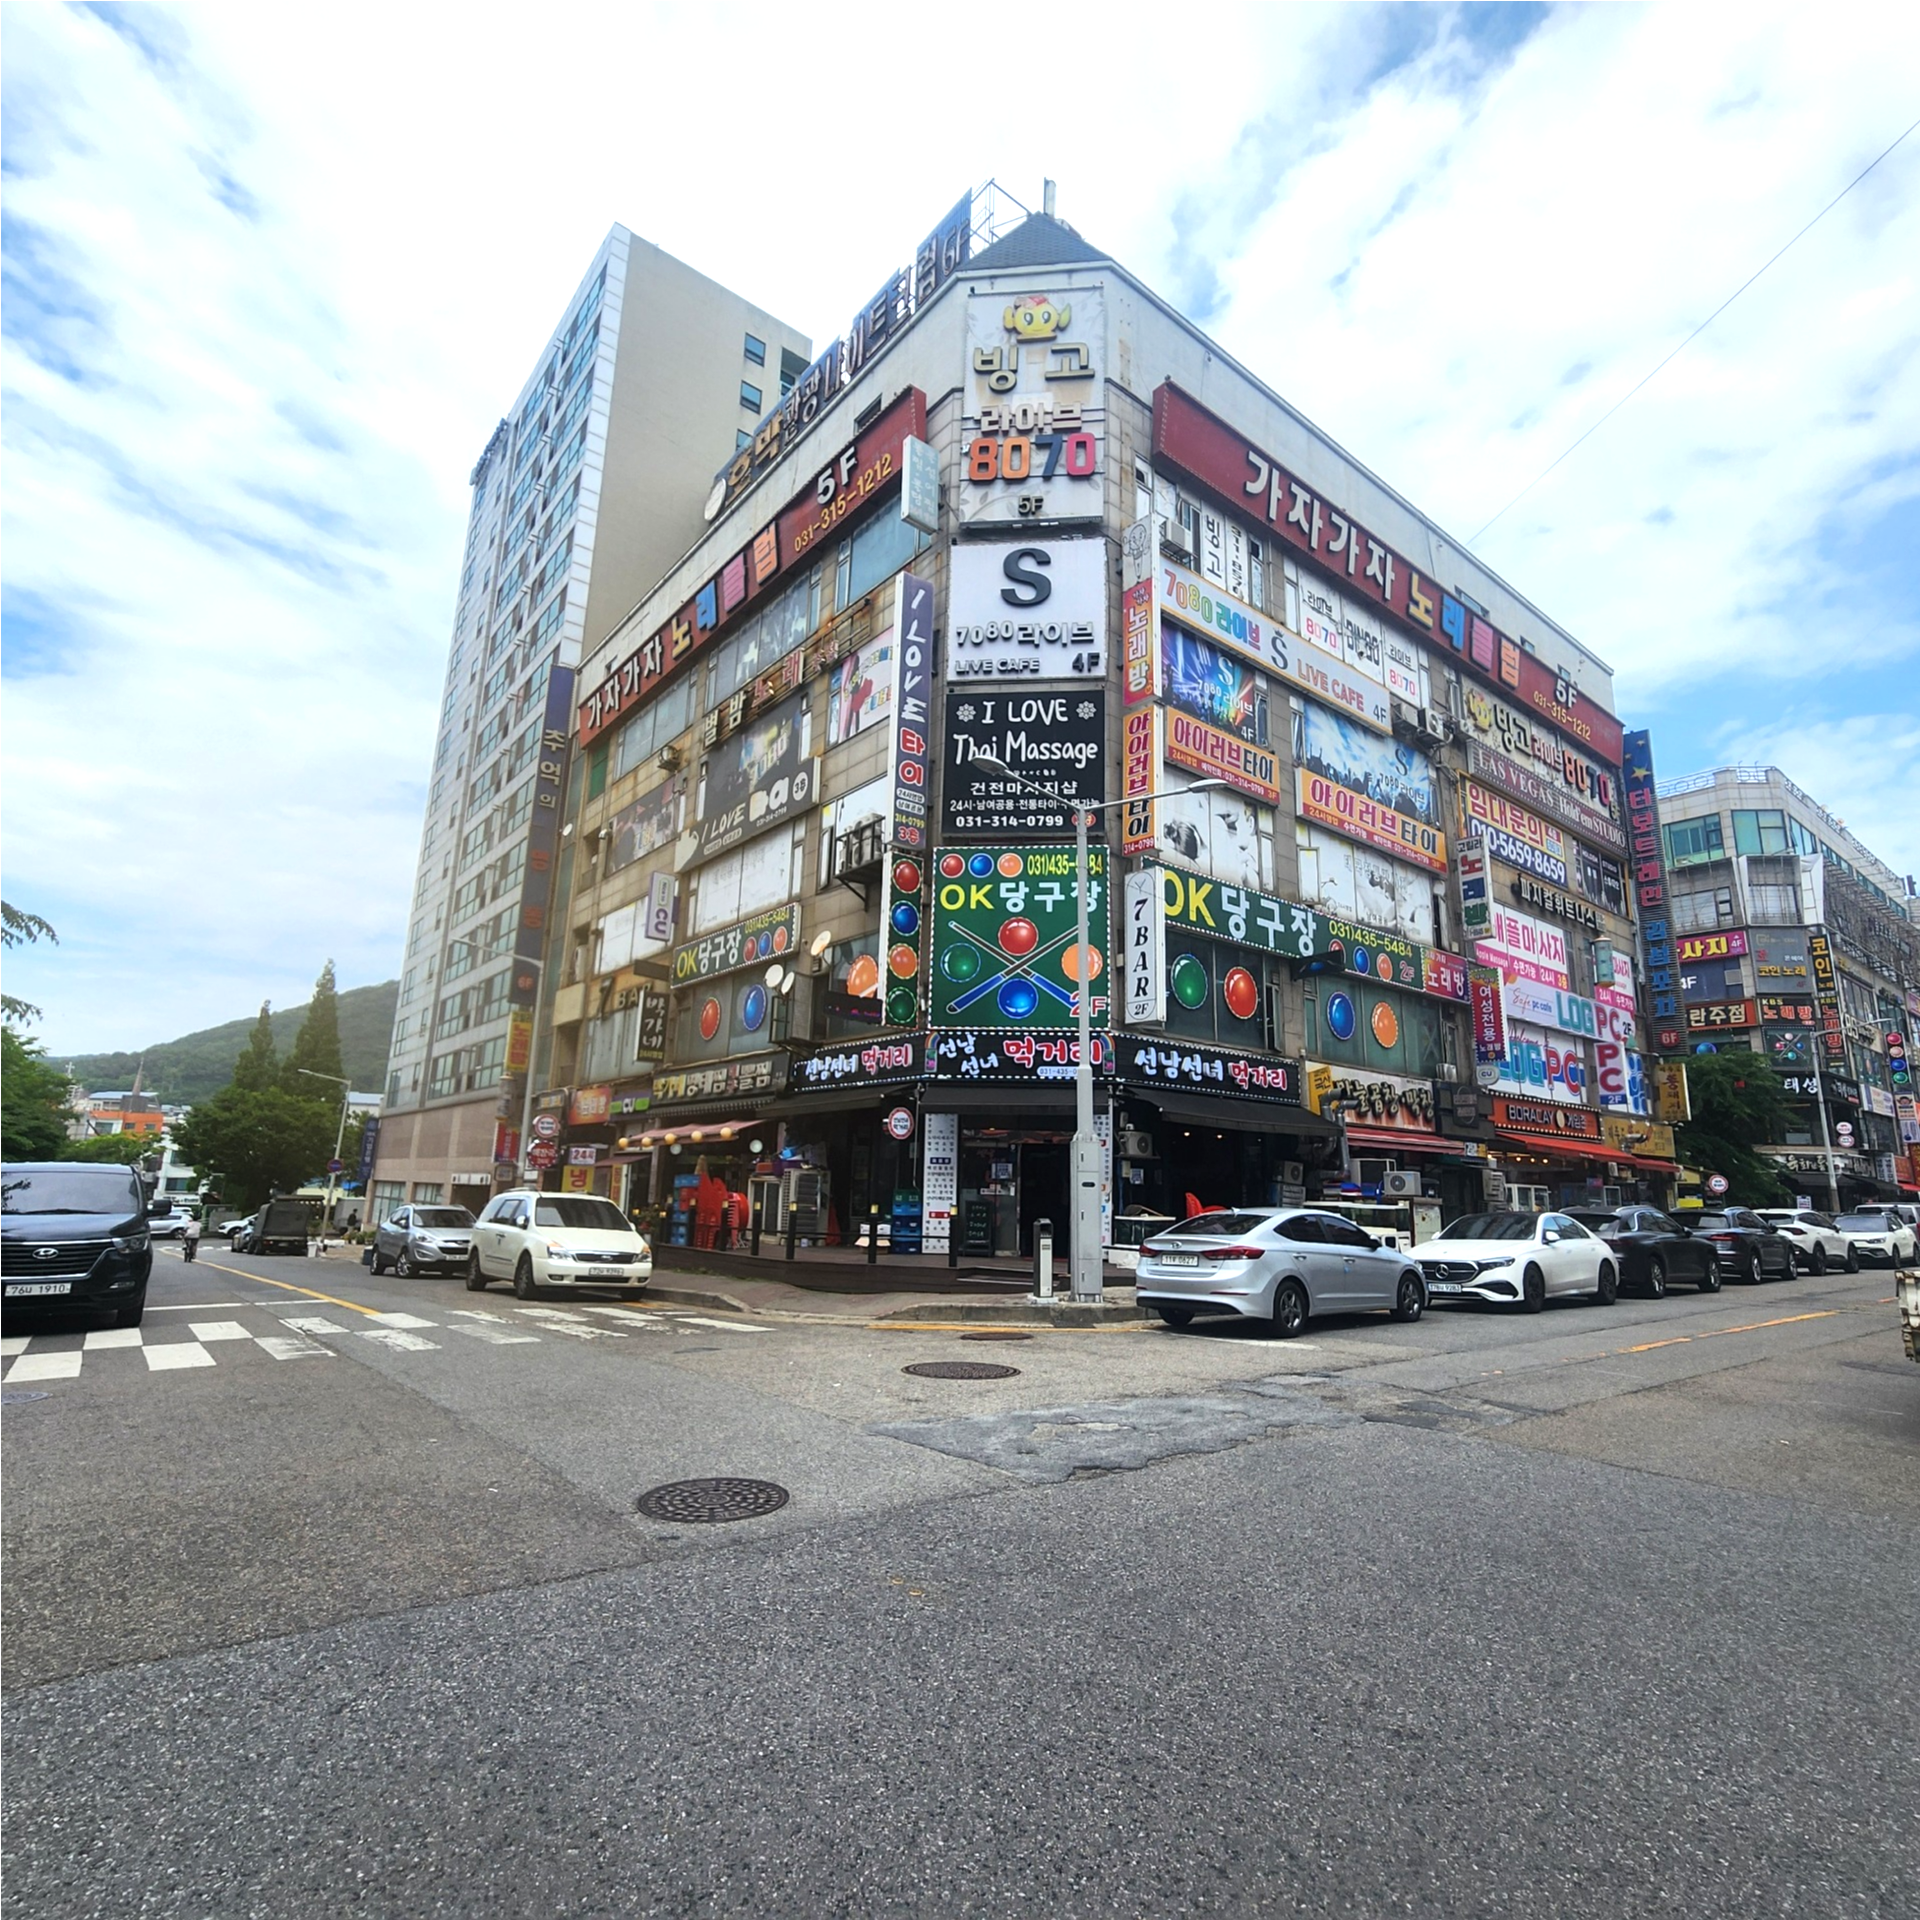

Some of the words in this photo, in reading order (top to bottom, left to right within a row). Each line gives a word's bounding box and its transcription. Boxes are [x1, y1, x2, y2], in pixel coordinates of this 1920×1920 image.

[973, 342, 1095, 393] 빙고
[980, 402, 1082, 434] 라이브
[817, 446, 857, 505] 5F
[969, 432, 1097, 483] 8070
[794, 454, 893, 551] 031-315-1212
[1018, 495, 1044, 516] 5F
[1246, 451, 1395, 600] 가자가자
[1000, 548, 1052, 608] S
[1128, 606, 1149, 692] 노래방
[1306, 617, 1337, 649] 8070
[901, 618, 927, 723] LOVE
[955, 658, 993, 675] LIVE
[996, 657, 1040, 673] CAFE
[1072, 652, 1100, 672] 4F
[1271, 634, 1288, 670] S
[588, 634, 663, 729] 가자가자
[1198, 680, 1221, 696] 7080
[1218, 657, 1233, 685] S
[1389, 669, 1416, 696] 8070
[1297, 659, 1329, 693] LIVE
[1331, 679, 1364, 711] CAFE
[1373, 704, 1386, 721] 4F
[1555, 678, 1579, 708] 5F
[981, 701, 996, 724] I
[1008, 699, 1069, 726] LOVE
[1533, 690, 1591, 742] 031-315-1212
[953, 734, 997, 765] Thai
[1005, 730, 1098, 769] Massage
[1173, 715, 1274, 785] 아이러브타이
[1241, 726, 1254, 740] 4F
[539, 729, 565, 808] 추억의
[899, 727, 926, 787] 타이
[1394, 748, 1408, 777] S
[1494, 703, 1531, 756] 빙고
[1563, 750, 1610, 807] 8070
[1310, 778, 1438, 855] 아이러브타이
[1469, 783, 1544, 847] 임대문의
[1479, 750, 1506, 780] LAS
[1509, 766, 1553, 807] VEGAS
[1592, 818, 1626, 848] STUDIO
[710, 803, 746, 835] LOVE
[955, 815, 1064, 827] 031-314-0799
[1124, 837, 1154, 854] 314-0799
[1629, 788, 1663, 906] 터보트레인
[940, 884, 994, 911] OK
[999, 880, 1102, 913] 당구장
[1164, 870, 1216, 928] OK
[1221, 885, 1317, 957] 당구장
[654, 908, 668, 934] CU
[1329, 920, 1412, 958] 031)435-5484
[677, 947, 698, 978] OK
[698, 929, 741, 973] 당구장
[1678, 936, 1728, 960] 사지
[1731, 939, 1743, 948] 4F
[1812, 938, 1832, 978] 코인
[1399, 960, 1414, 982] 2F
[1427, 964, 1465, 997] 노래방
[1758, 965, 1780, 977] 코인
[1782, 965, 1806, 977] 노래
[1134, 1003, 1149, 1016] 2F
[1479, 986, 1496, 1042] 여성전용
[1556, 990, 1594, 1036] LOG
[1594, 1003, 1621, 1041] PC
[1763, 1006, 1812, 1019] 노래방
[1822, 1005, 1842, 1047] 노래방
[939, 1033, 976, 1057] 선남
[1003, 1036, 1102, 1068] 먹거리
[1661, 1032, 1677, 1044] 6F
[805, 1054, 858, 1082] 선남선녀
[861, 1043, 913, 1075] 먹거리
[961, 1052, 999, 1076] 선녀
[1134, 1046, 1224, 1082] 선남선녀
[1227, 1060, 1288, 1091] 먹거리
[1543, 1046, 1581, 1096] PC
[1597, 1043, 1624, 1093] PC
[1608, 1095, 1622, 1104] 2F
[1784, 1077, 1818, 1094] 태성
[1509, 1105, 1554, 1124] BORACAY
[39, 1285, 65, 1293] 1910
